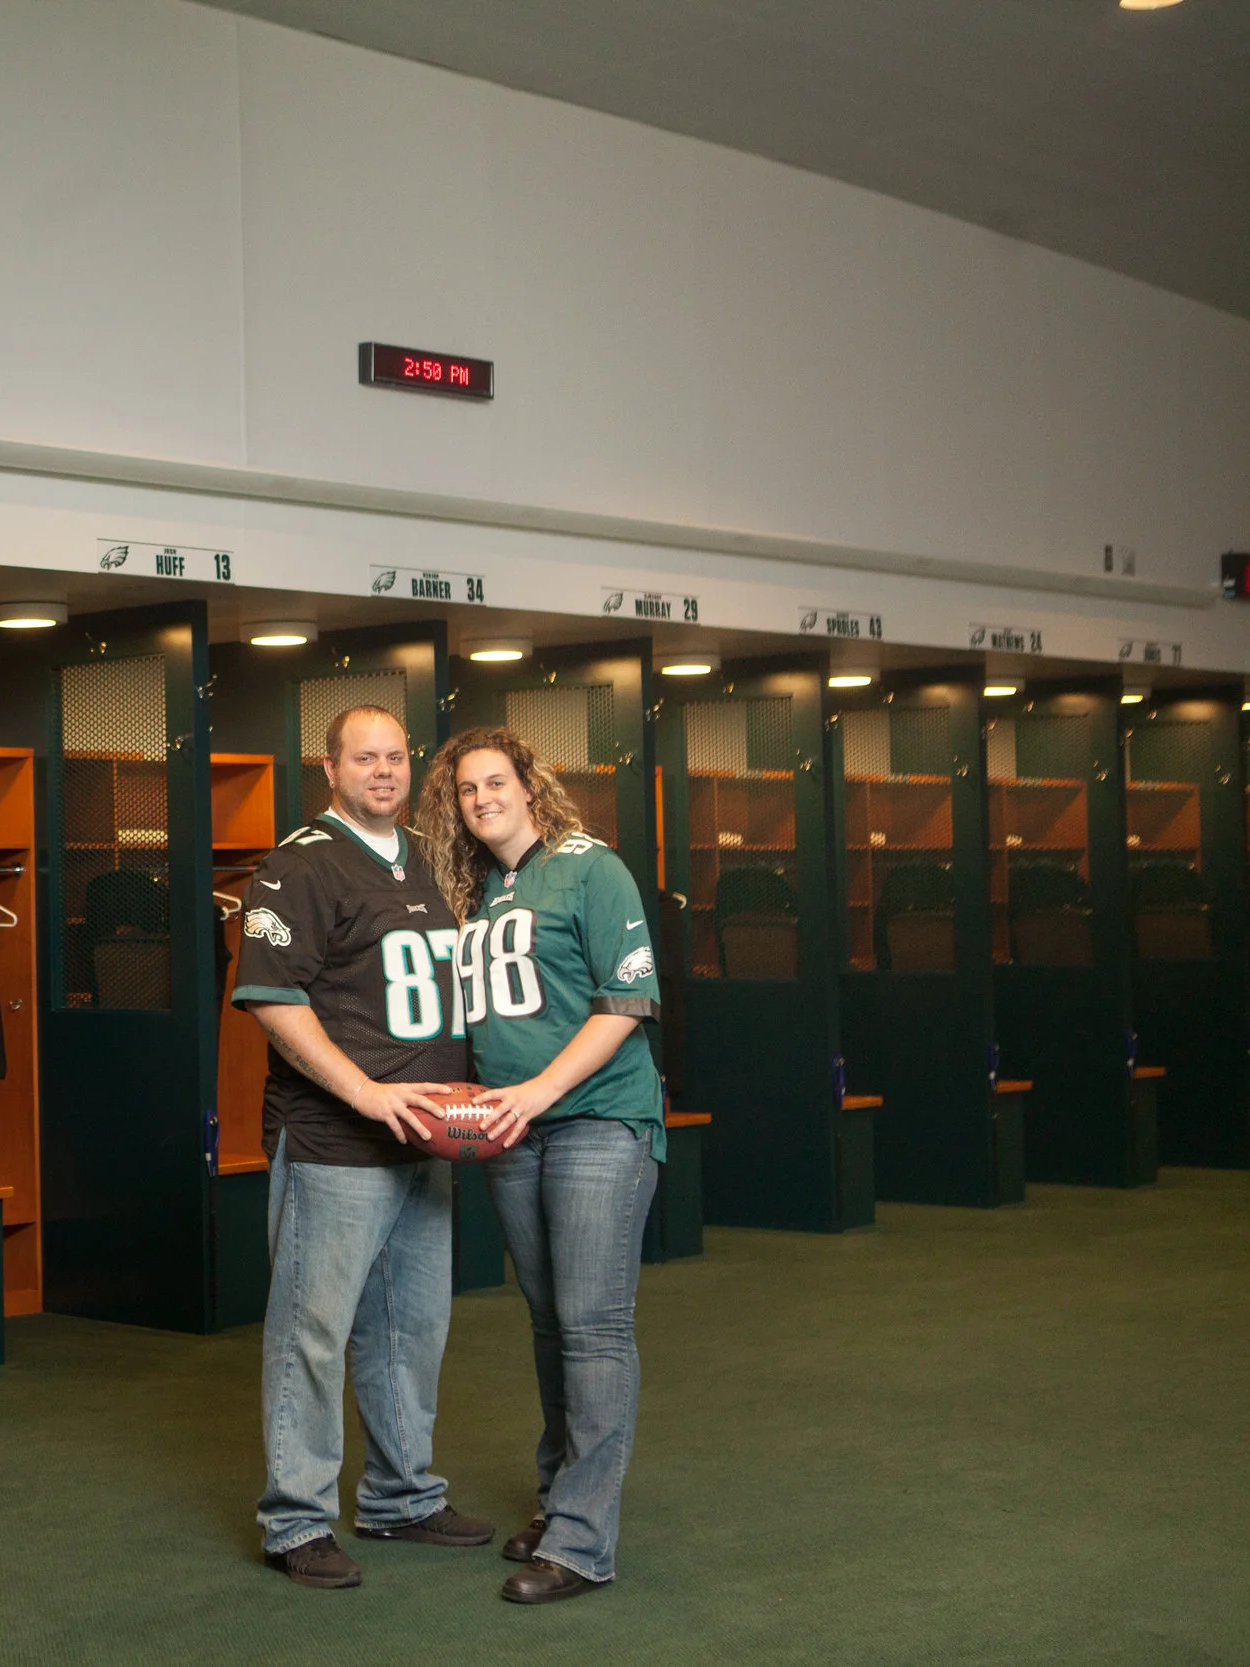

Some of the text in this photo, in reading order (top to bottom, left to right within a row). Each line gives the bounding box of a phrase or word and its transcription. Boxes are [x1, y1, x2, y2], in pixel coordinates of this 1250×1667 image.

[404, 357, 469, 386] 2:50 PM
[155, 553, 231, 580] HUFF 13
[411, 577, 484, 602] BARNER 34
[634, 598, 698, 622] MURRAY 29
[456, 907, 547, 1029] 98
[381, 929, 467, 1041] 87
